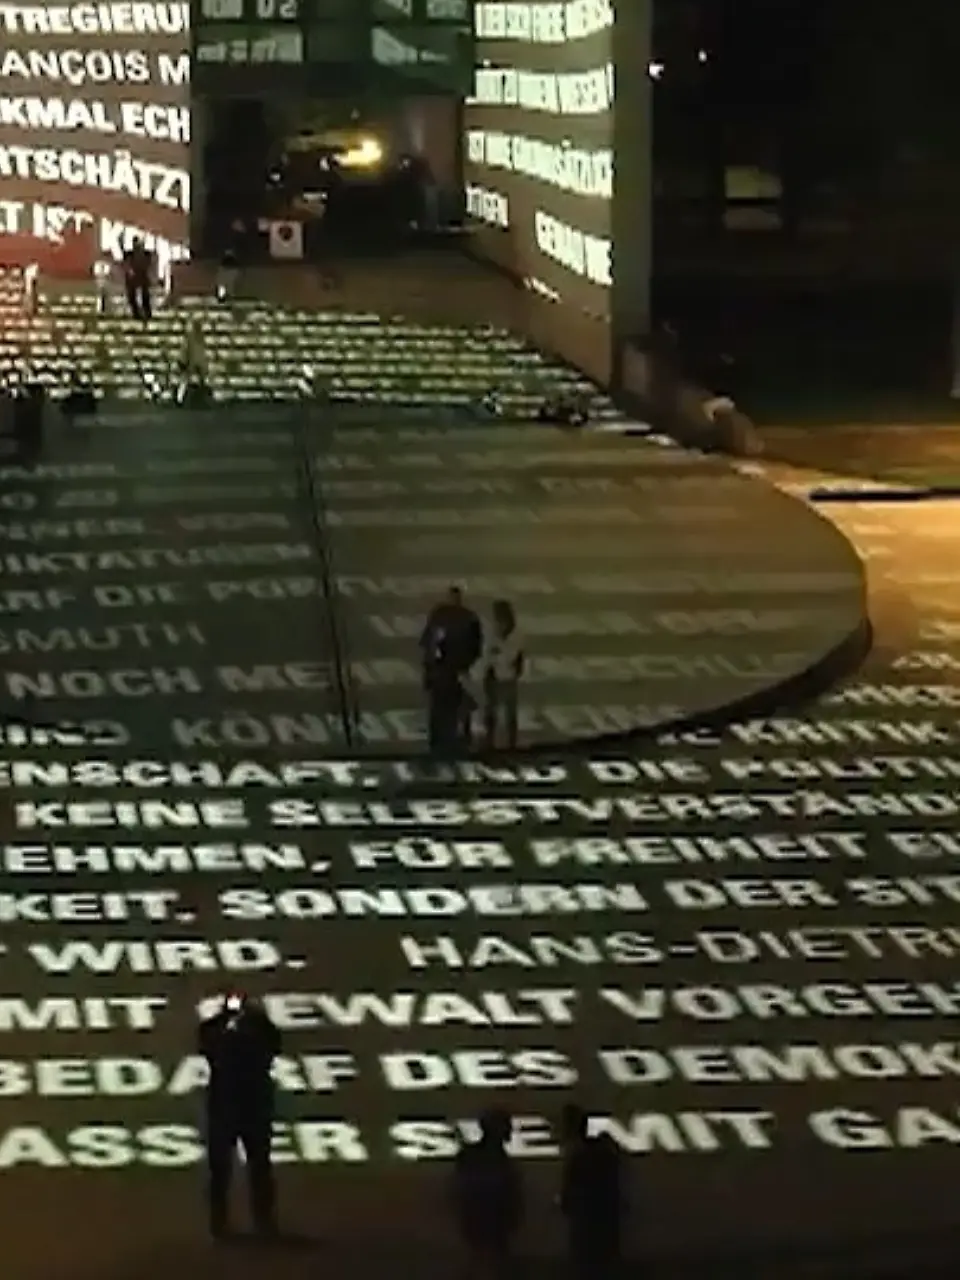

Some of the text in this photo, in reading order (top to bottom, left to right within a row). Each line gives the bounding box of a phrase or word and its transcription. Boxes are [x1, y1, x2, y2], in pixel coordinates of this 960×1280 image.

[5, 666, 200, 699] NOCH
[13, 799, 252, 829] KEINE
[347, 835, 514, 870] FÜR
[529, 832, 871, 867] FREIHEIT
[216, 879, 649, 919] SONDERN
[662, 876, 840, 908] DER
[26, 937, 310, 974] WIRD.
[195, 988, 580, 1029] EWALT
[378, 1048, 580, 1090] DES
